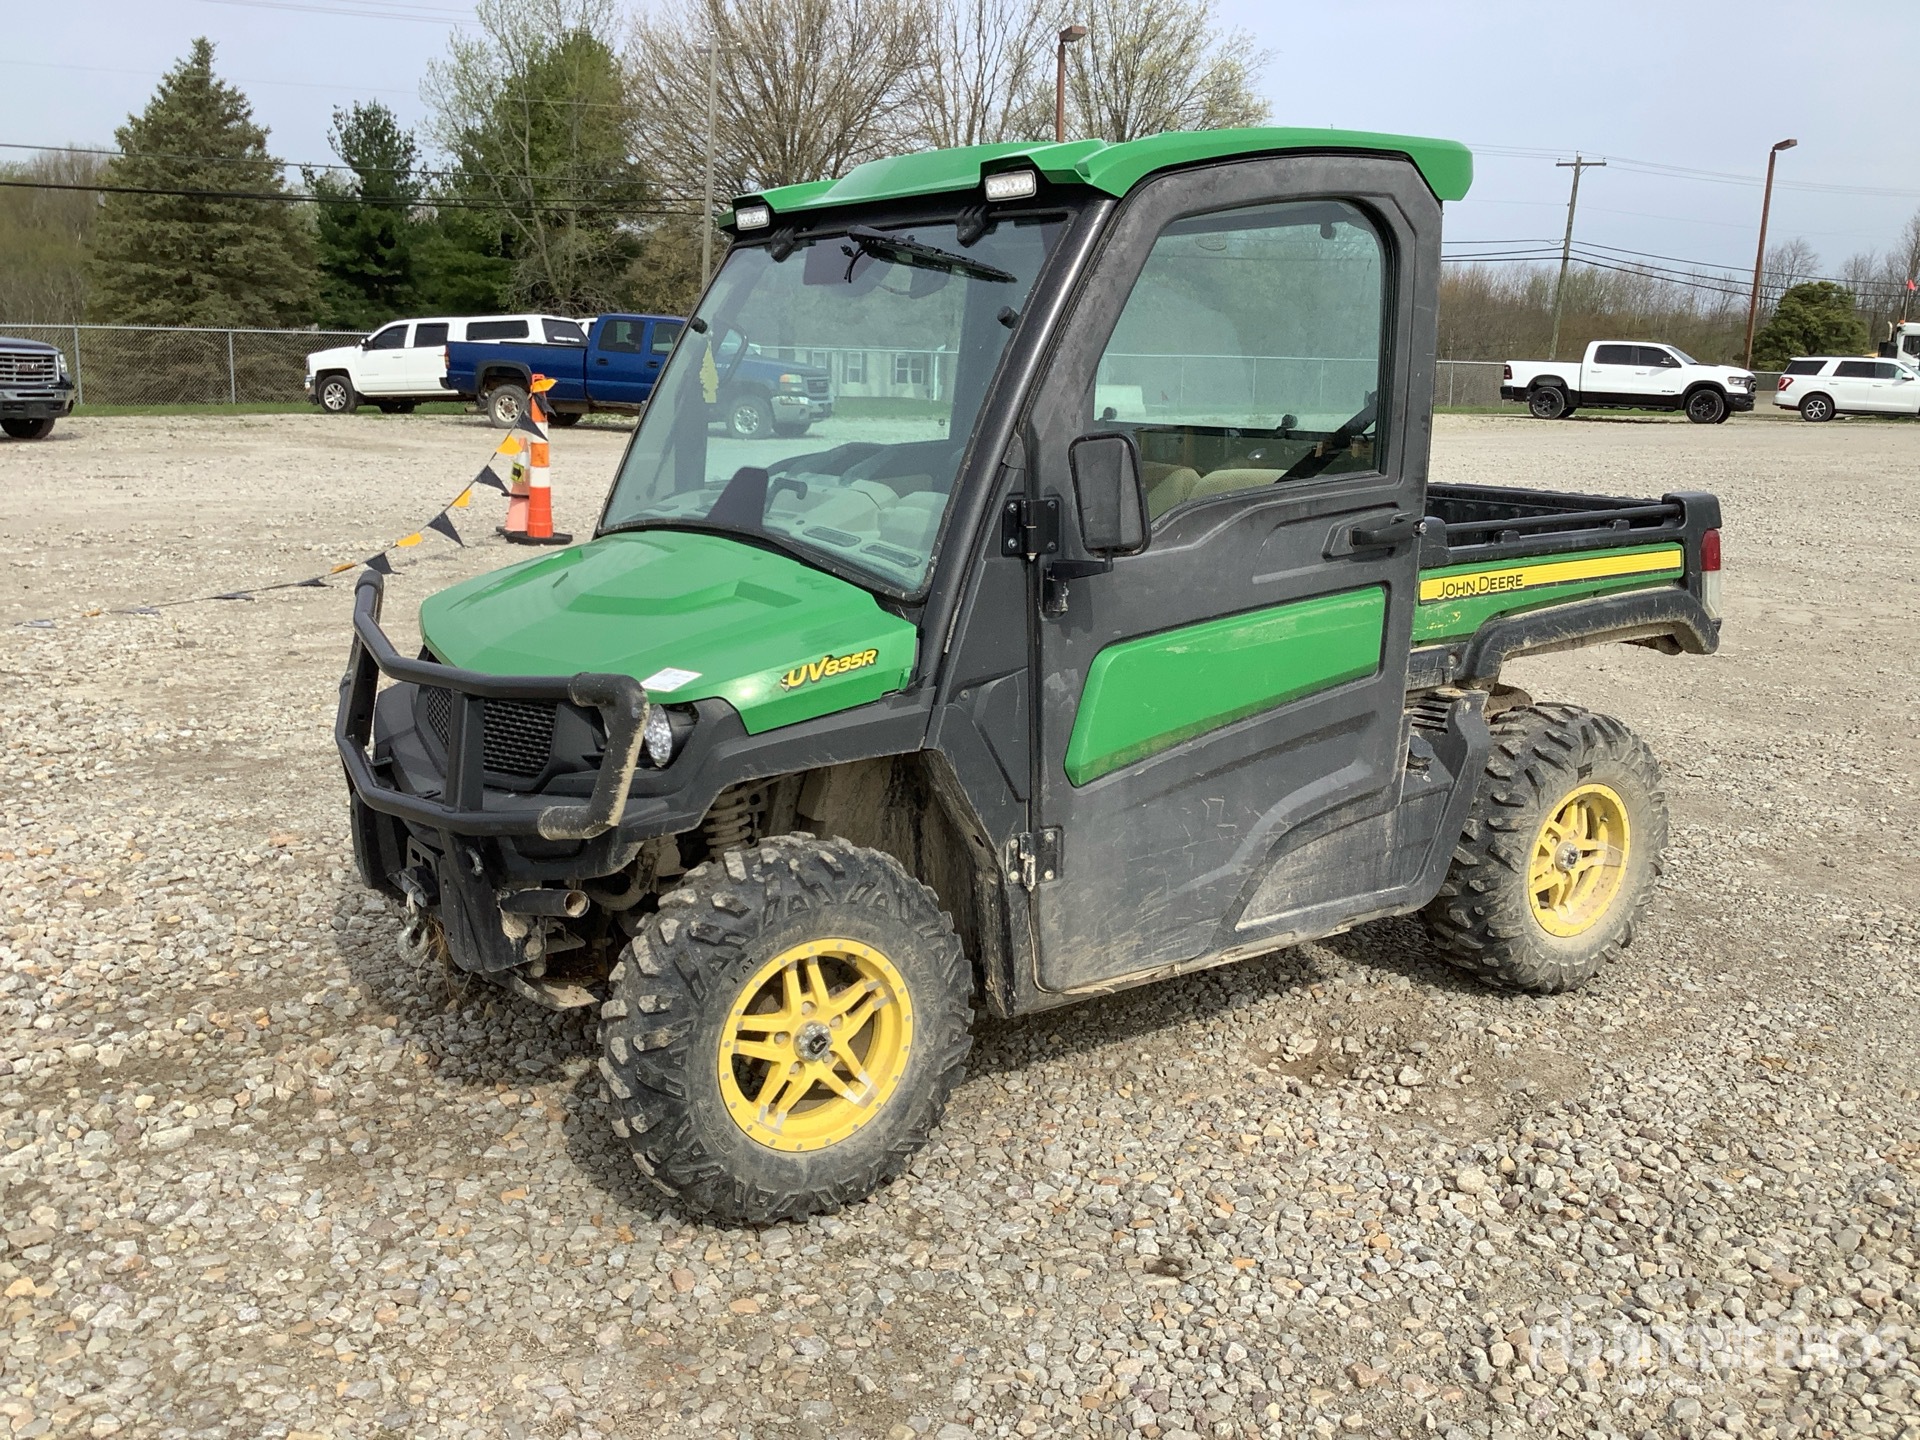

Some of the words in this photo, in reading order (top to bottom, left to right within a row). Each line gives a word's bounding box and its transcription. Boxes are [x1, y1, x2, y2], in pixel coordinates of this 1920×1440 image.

[1438, 581, 1476, 598] JOHN
[1478, 574, 1523, 592] DEERE
[780, 648, 879, 692] UV835R
